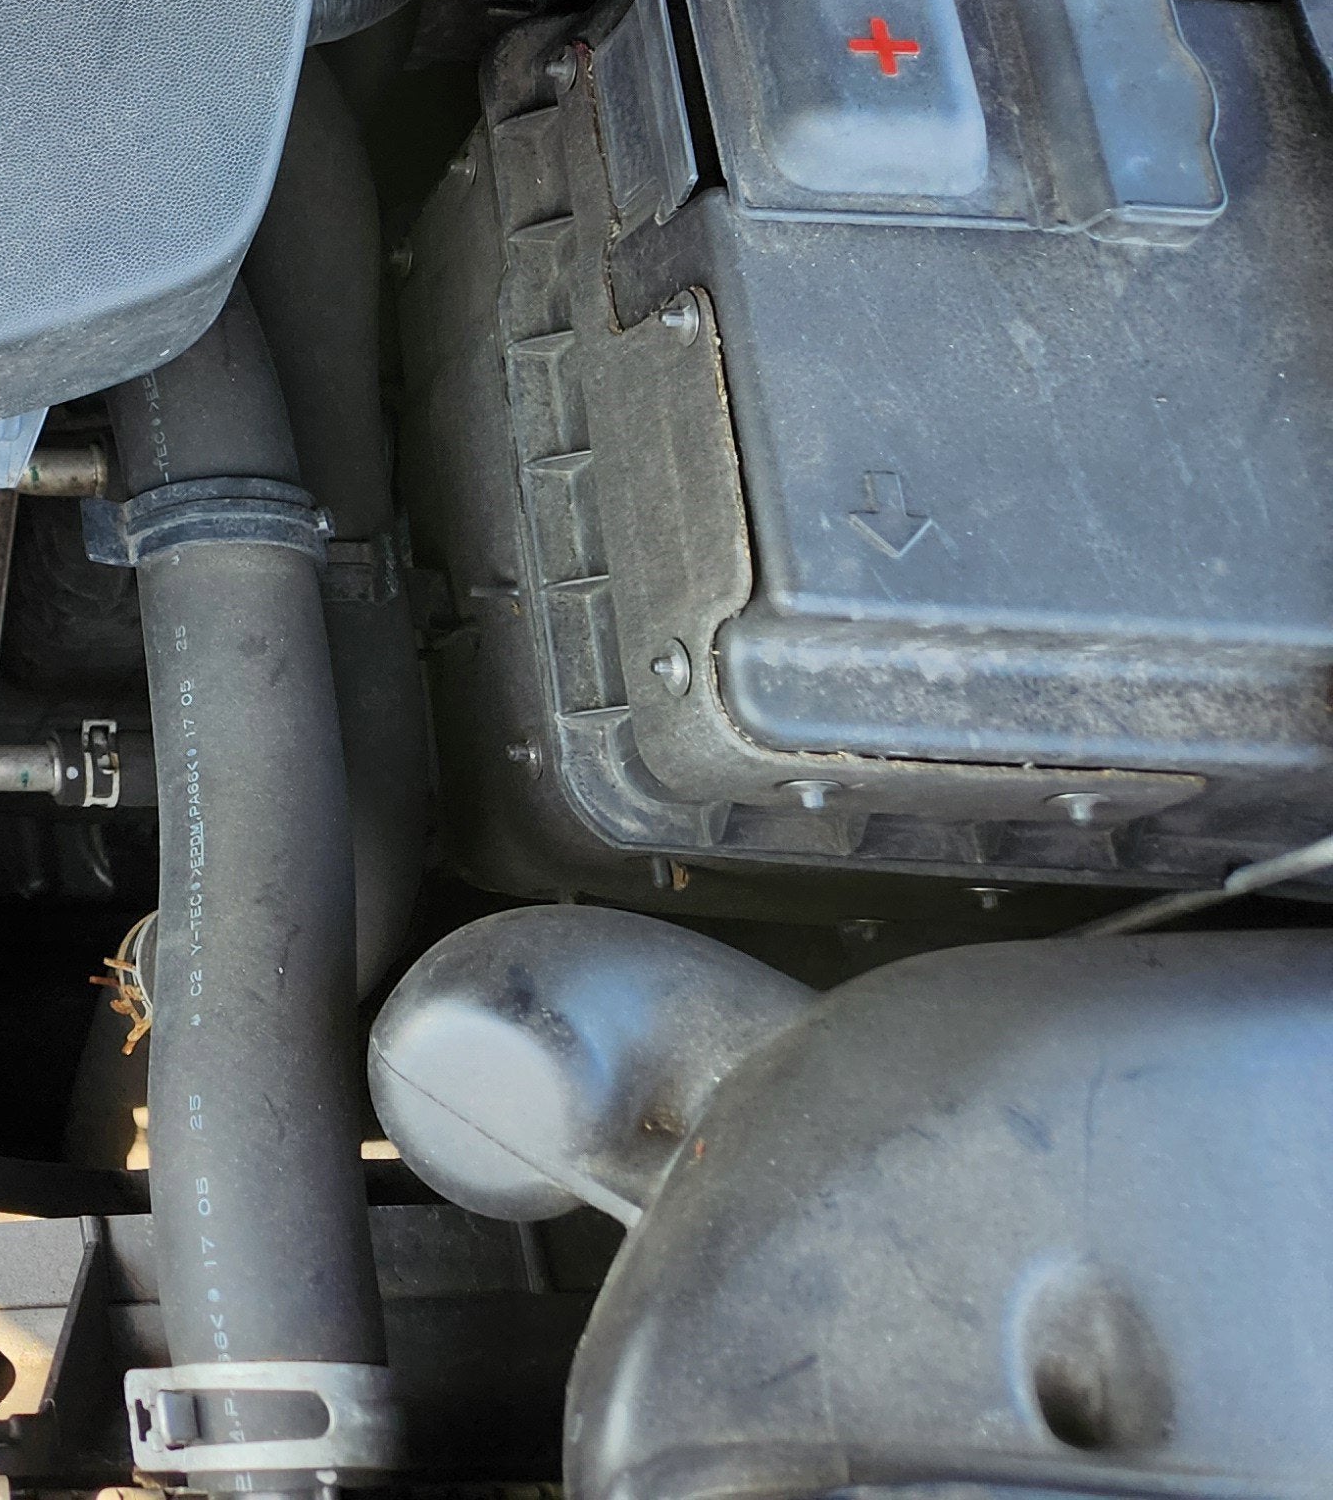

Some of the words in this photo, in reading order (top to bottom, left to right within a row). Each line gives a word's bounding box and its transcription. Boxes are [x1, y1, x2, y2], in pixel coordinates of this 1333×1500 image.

[189, 893, 204, 956] Y-TEC
[189, 969, 203, 996] C2
[188, 1095, 203, 1130] 25
[196, 1176, 211, 1216] 05
